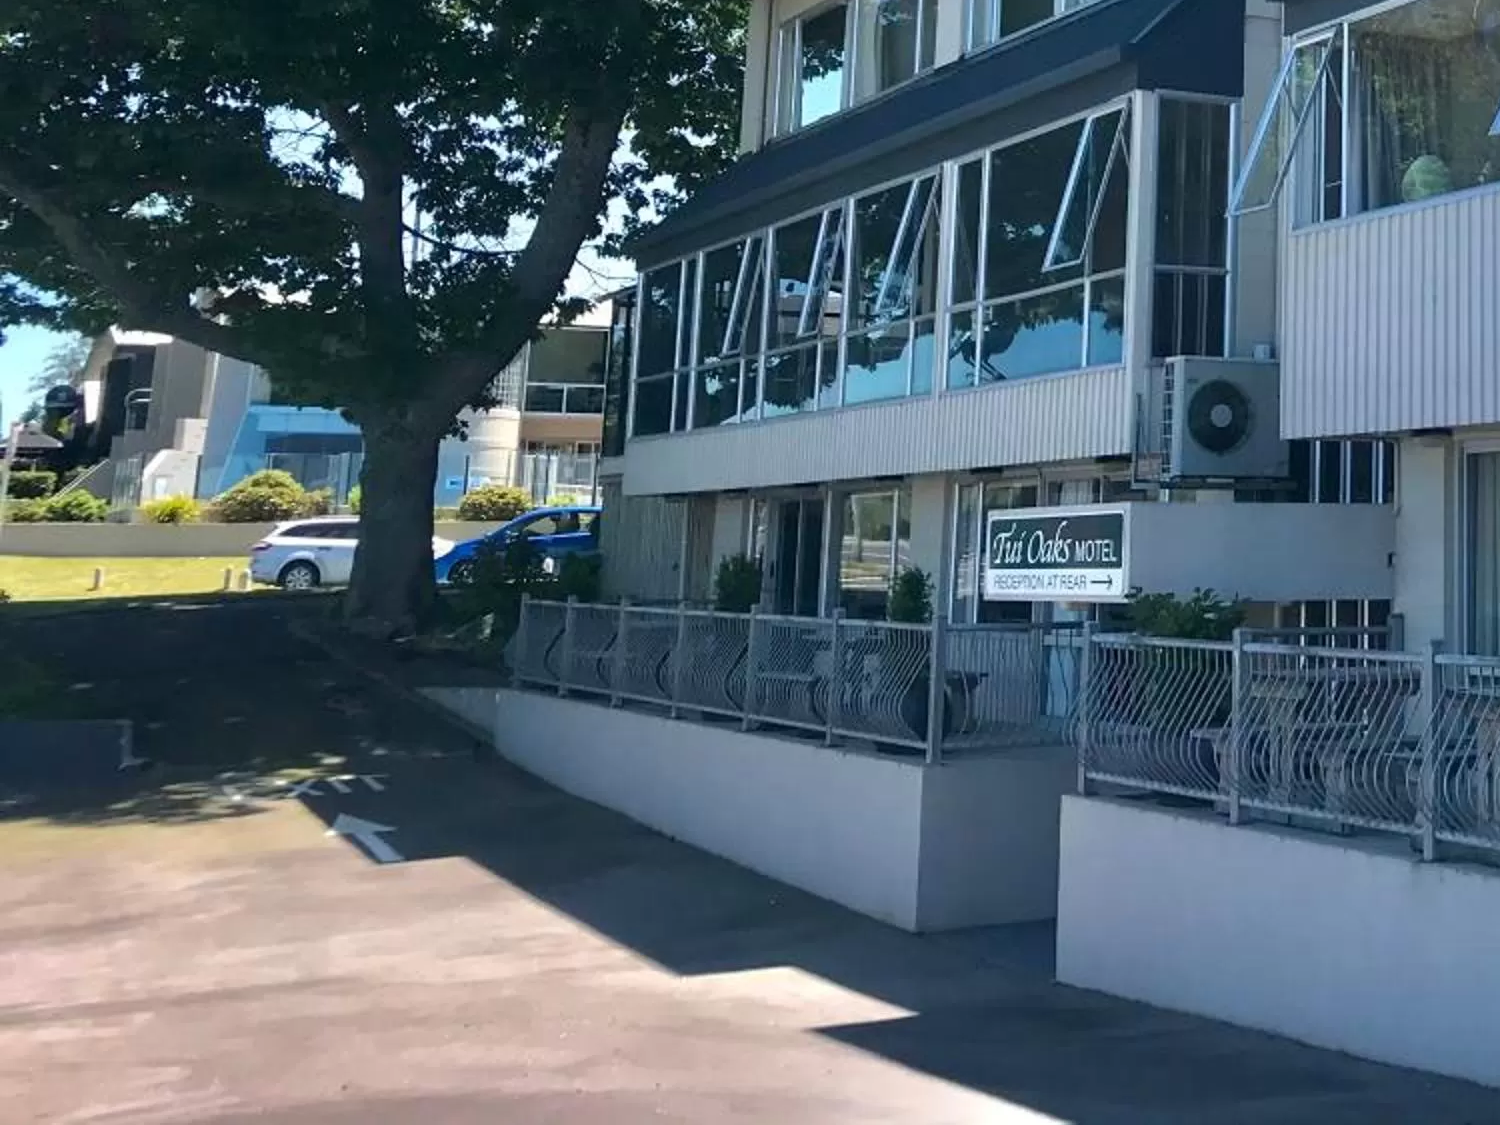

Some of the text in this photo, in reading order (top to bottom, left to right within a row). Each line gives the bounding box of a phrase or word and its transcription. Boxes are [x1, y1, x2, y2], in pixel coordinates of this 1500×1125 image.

[993, 520, 1117, 564] Tui Oaks MOTEL
[994, 574, 1087, 591] RECEPTION AT REAR
